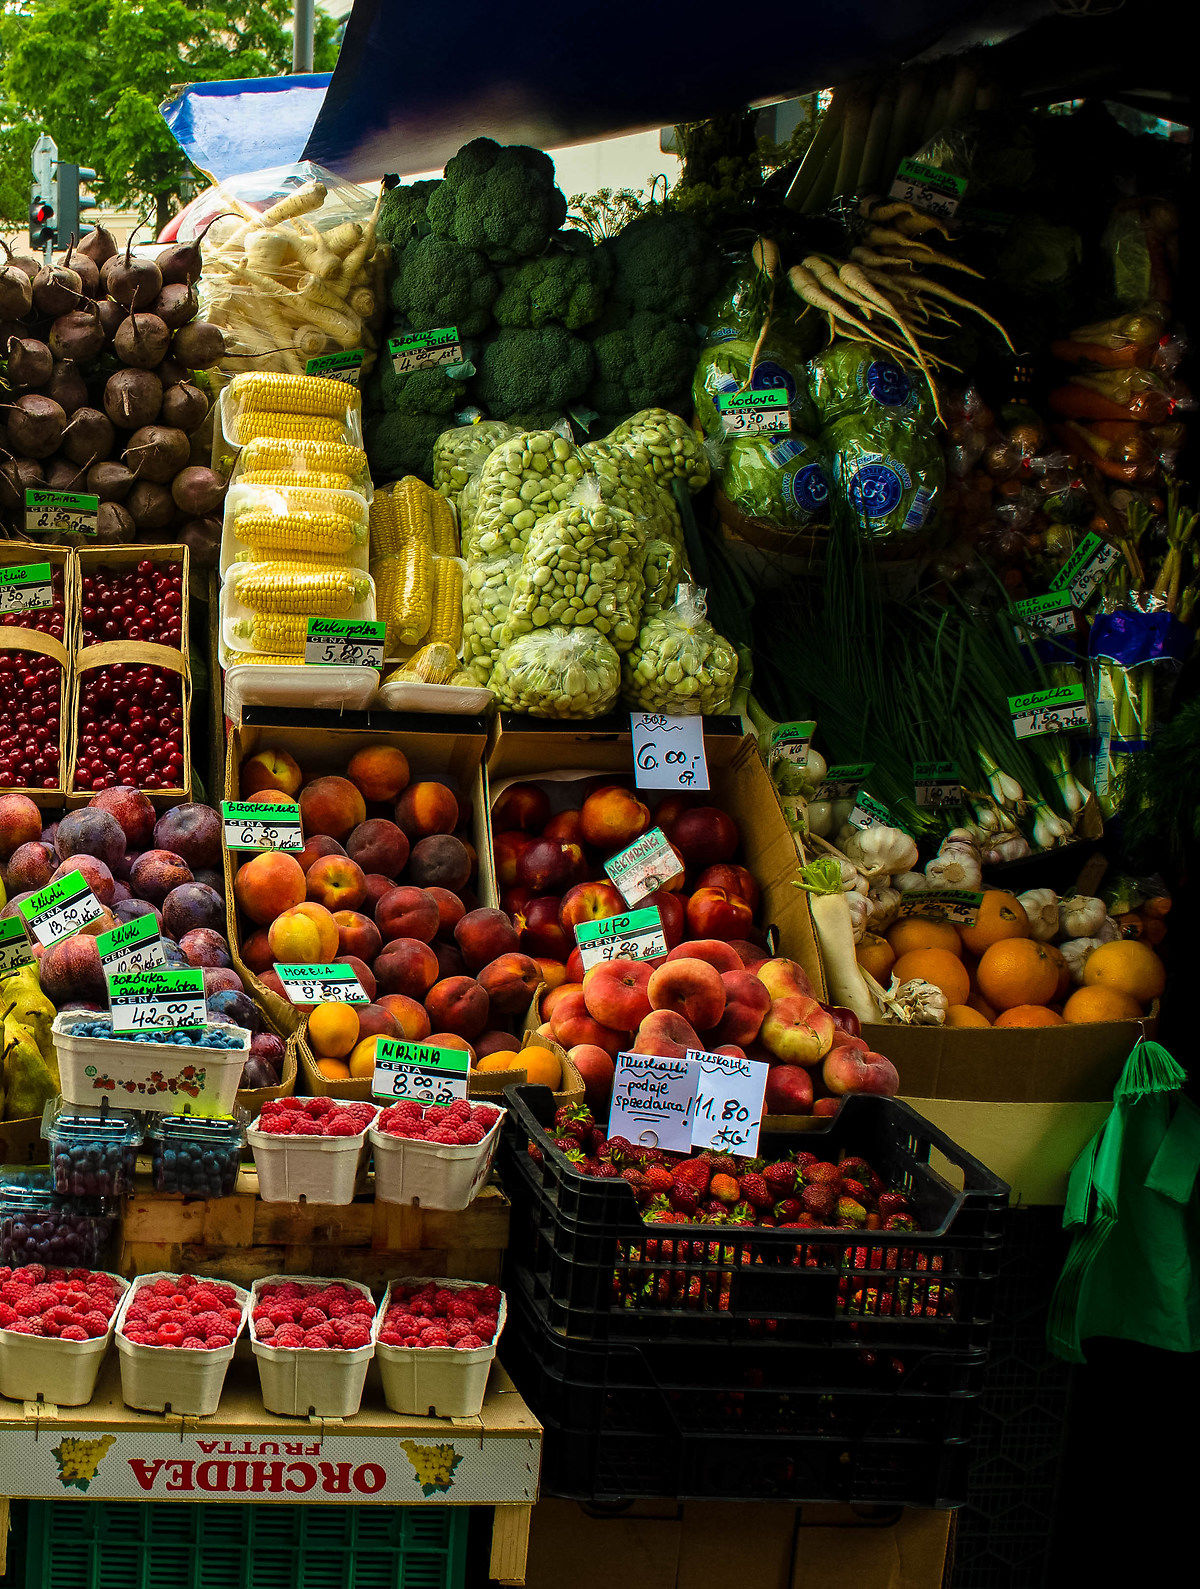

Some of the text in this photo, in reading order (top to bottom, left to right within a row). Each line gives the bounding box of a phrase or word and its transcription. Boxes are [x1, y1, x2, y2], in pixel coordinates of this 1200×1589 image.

[311, 636, 346, 644] CENA
[229, 820, 264, 828] CENA
[32, 905, 64, 926] CENA
[598, 917, 630, 935] UFO
[104, 947, 132, 964] CENA
[283, 967, 335, 977] MORELA
[116, 995, 160, 1005] CENA
[380, 1063, 422, 1075] CENA
[195, 1439, 323, 1457] FRUTTA
[128, 1457, 389, 1495] ORCHIDEA
